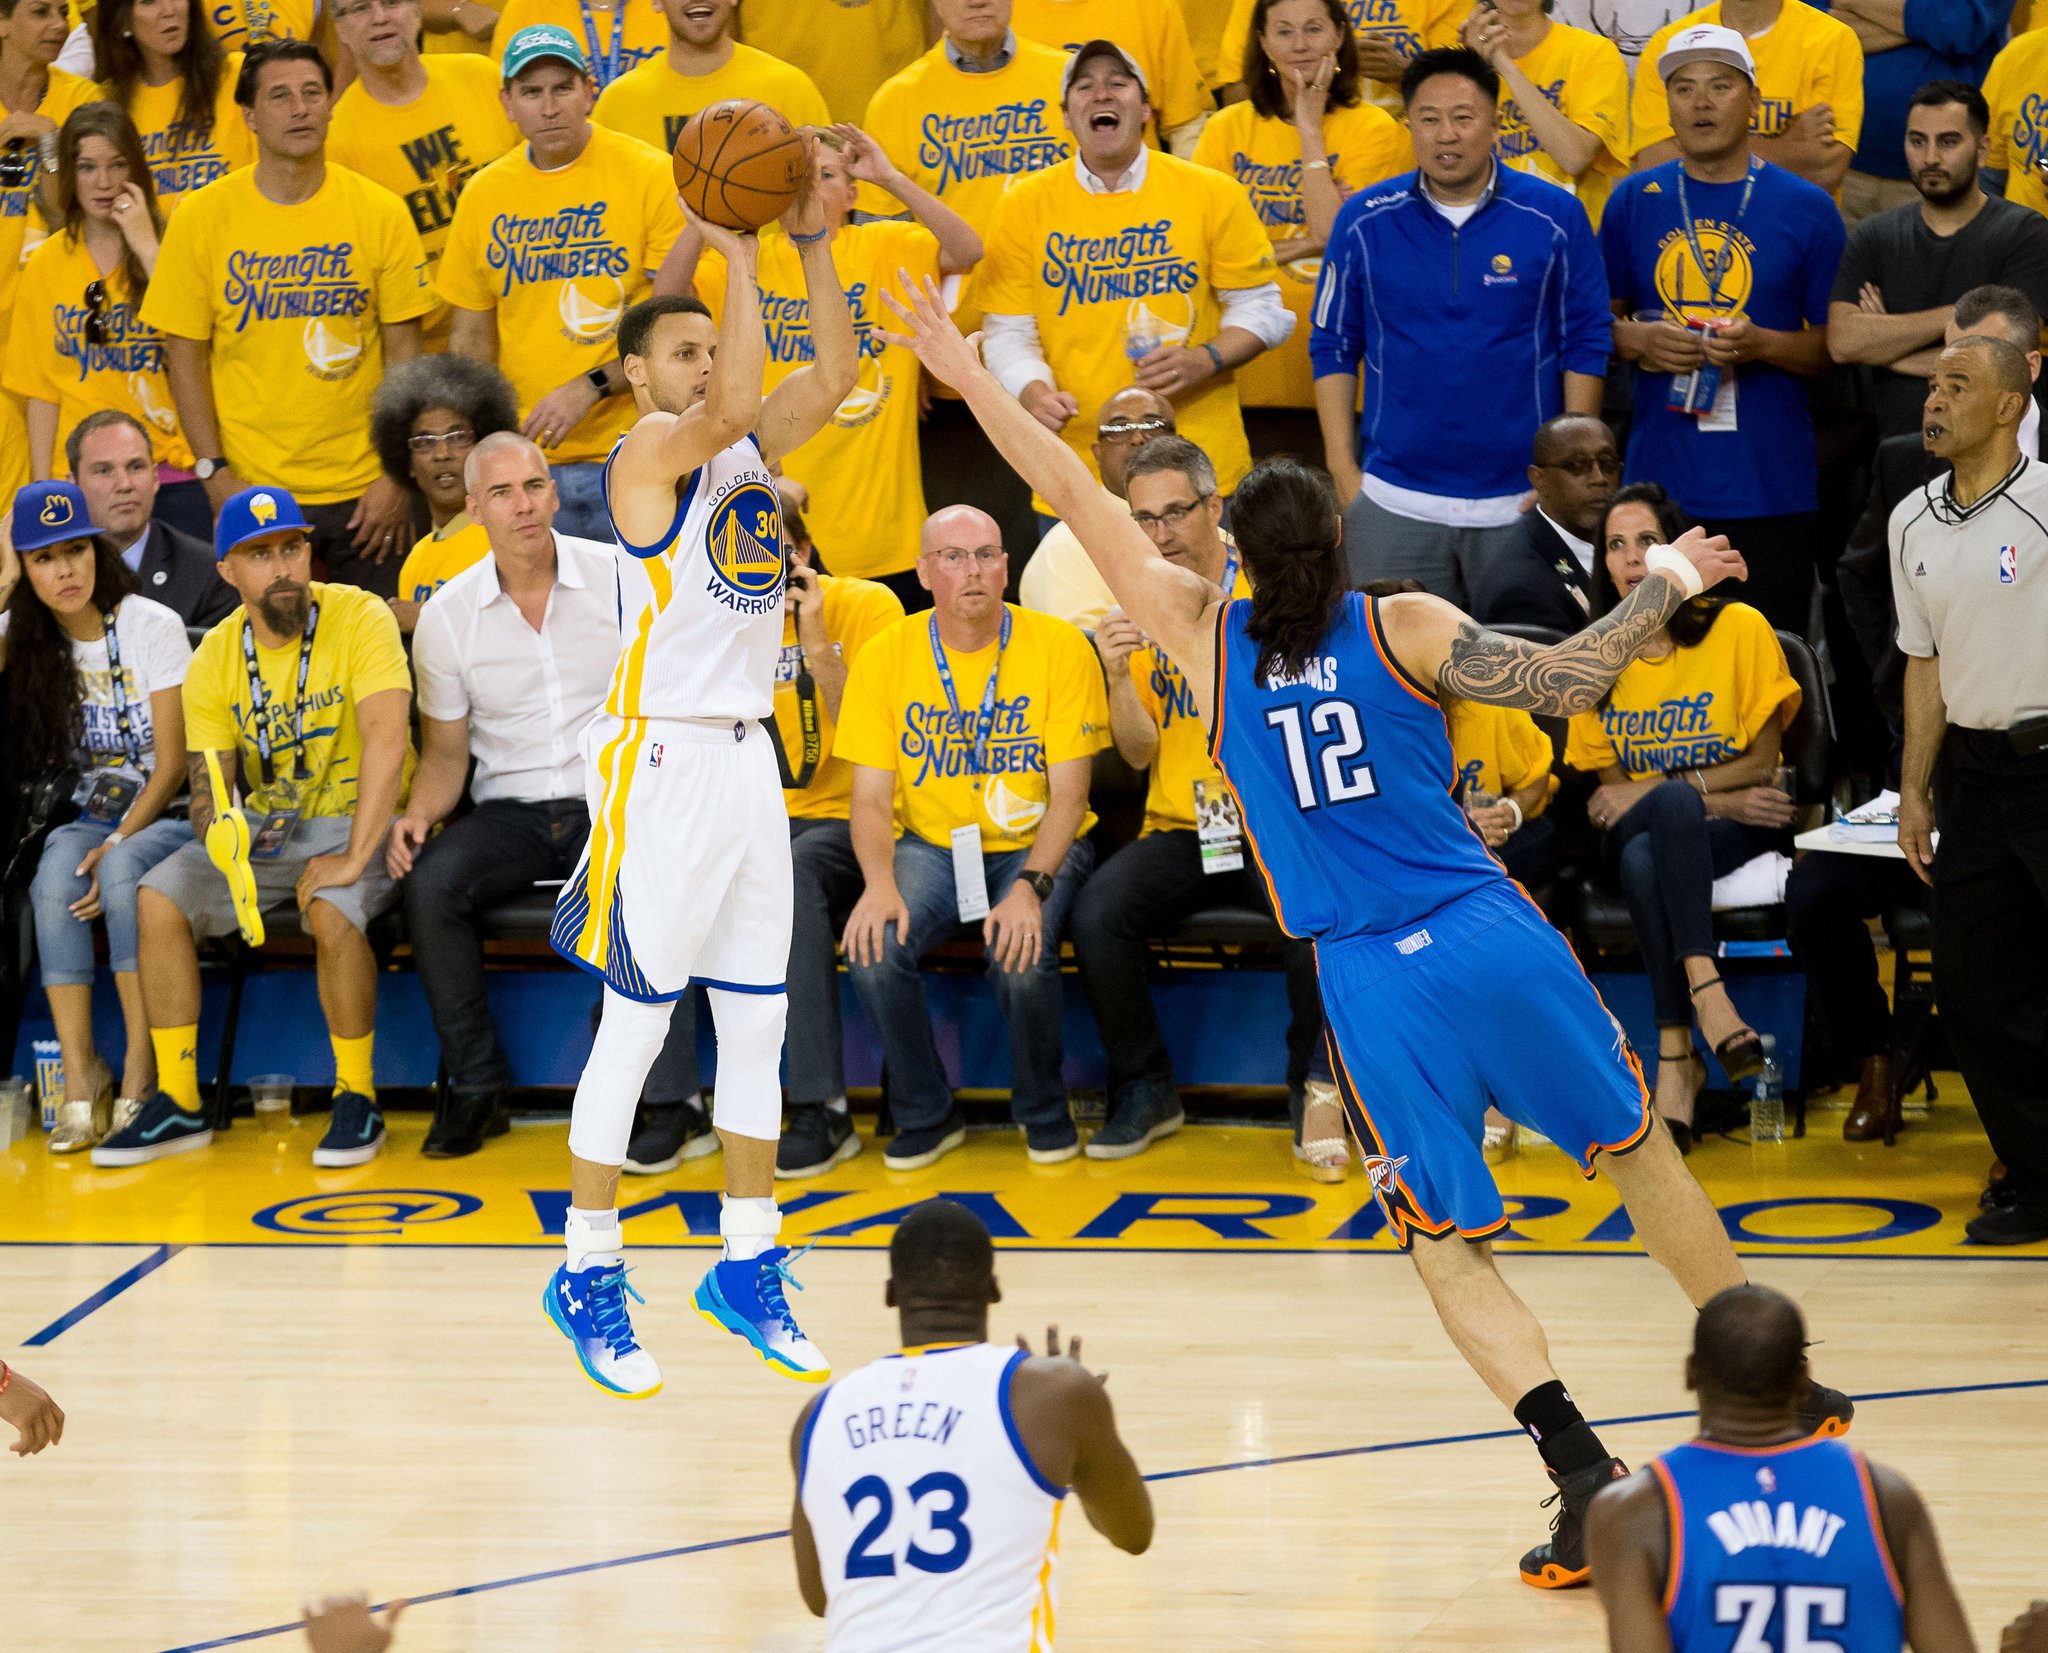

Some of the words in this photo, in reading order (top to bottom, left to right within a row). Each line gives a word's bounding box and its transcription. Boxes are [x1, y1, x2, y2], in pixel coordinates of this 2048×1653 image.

[399, 123, 471, 184] WE
[919, 98, 1048, 169] Strength
[936, 141, 1071, 195] NUMBERS
[487, 200, 607, 269] Strength
[1043, 219, 1174, 290] Strength
[1657, 218, 1715, 249] GOLEN
[225, 242, 353, 305] Strength
[502, 245, 630, 297] NUMBERS
[1058, 261, 1199, 316] NUMBERS
[235, 281, 371, 332] NUMBERS
[708, 470, 759, 507] GOLDEN
[754, 510, 779, 540] 30
[801, 699, 816, 733] Nikon
[901, 695, 1031, 758] Strenth
[1600, 691, 1715, 743] trength
[1263, 698, 1380, 812] 12
[1393, 927, 1434, 956] THUNDER
[1368, 1161, 1389, 1188] OKC
[844, 1401, 965, 1450] GREEN
[842, 1470, 974, 1580] 23
[1705, 1500, 1847, 1559] DURANT
[1713, 1582, 1848, 1653] 35
